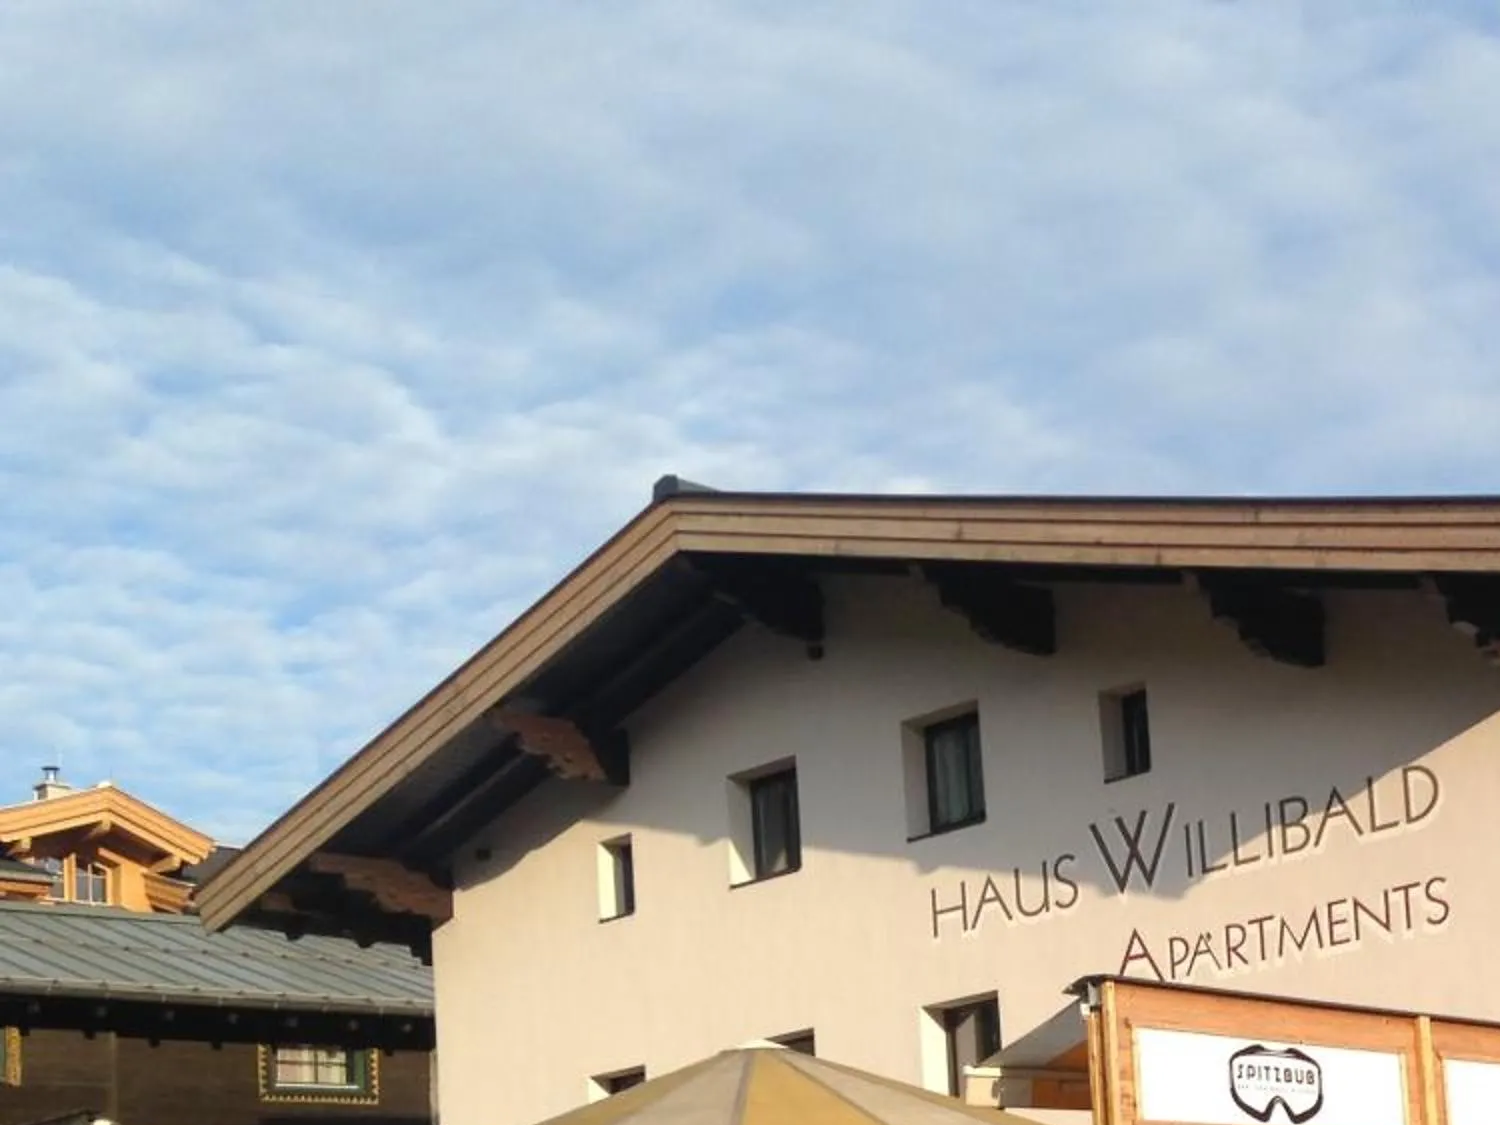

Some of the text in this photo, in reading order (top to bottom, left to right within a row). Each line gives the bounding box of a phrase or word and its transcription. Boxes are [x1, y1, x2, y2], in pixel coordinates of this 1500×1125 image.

[931, 764, 1440, 938] HAUS WILLIBALD
[1119, 876, 1450, 982] APARTMENTS
[1237, 1063, 1315, 1085] SPITZBUB
